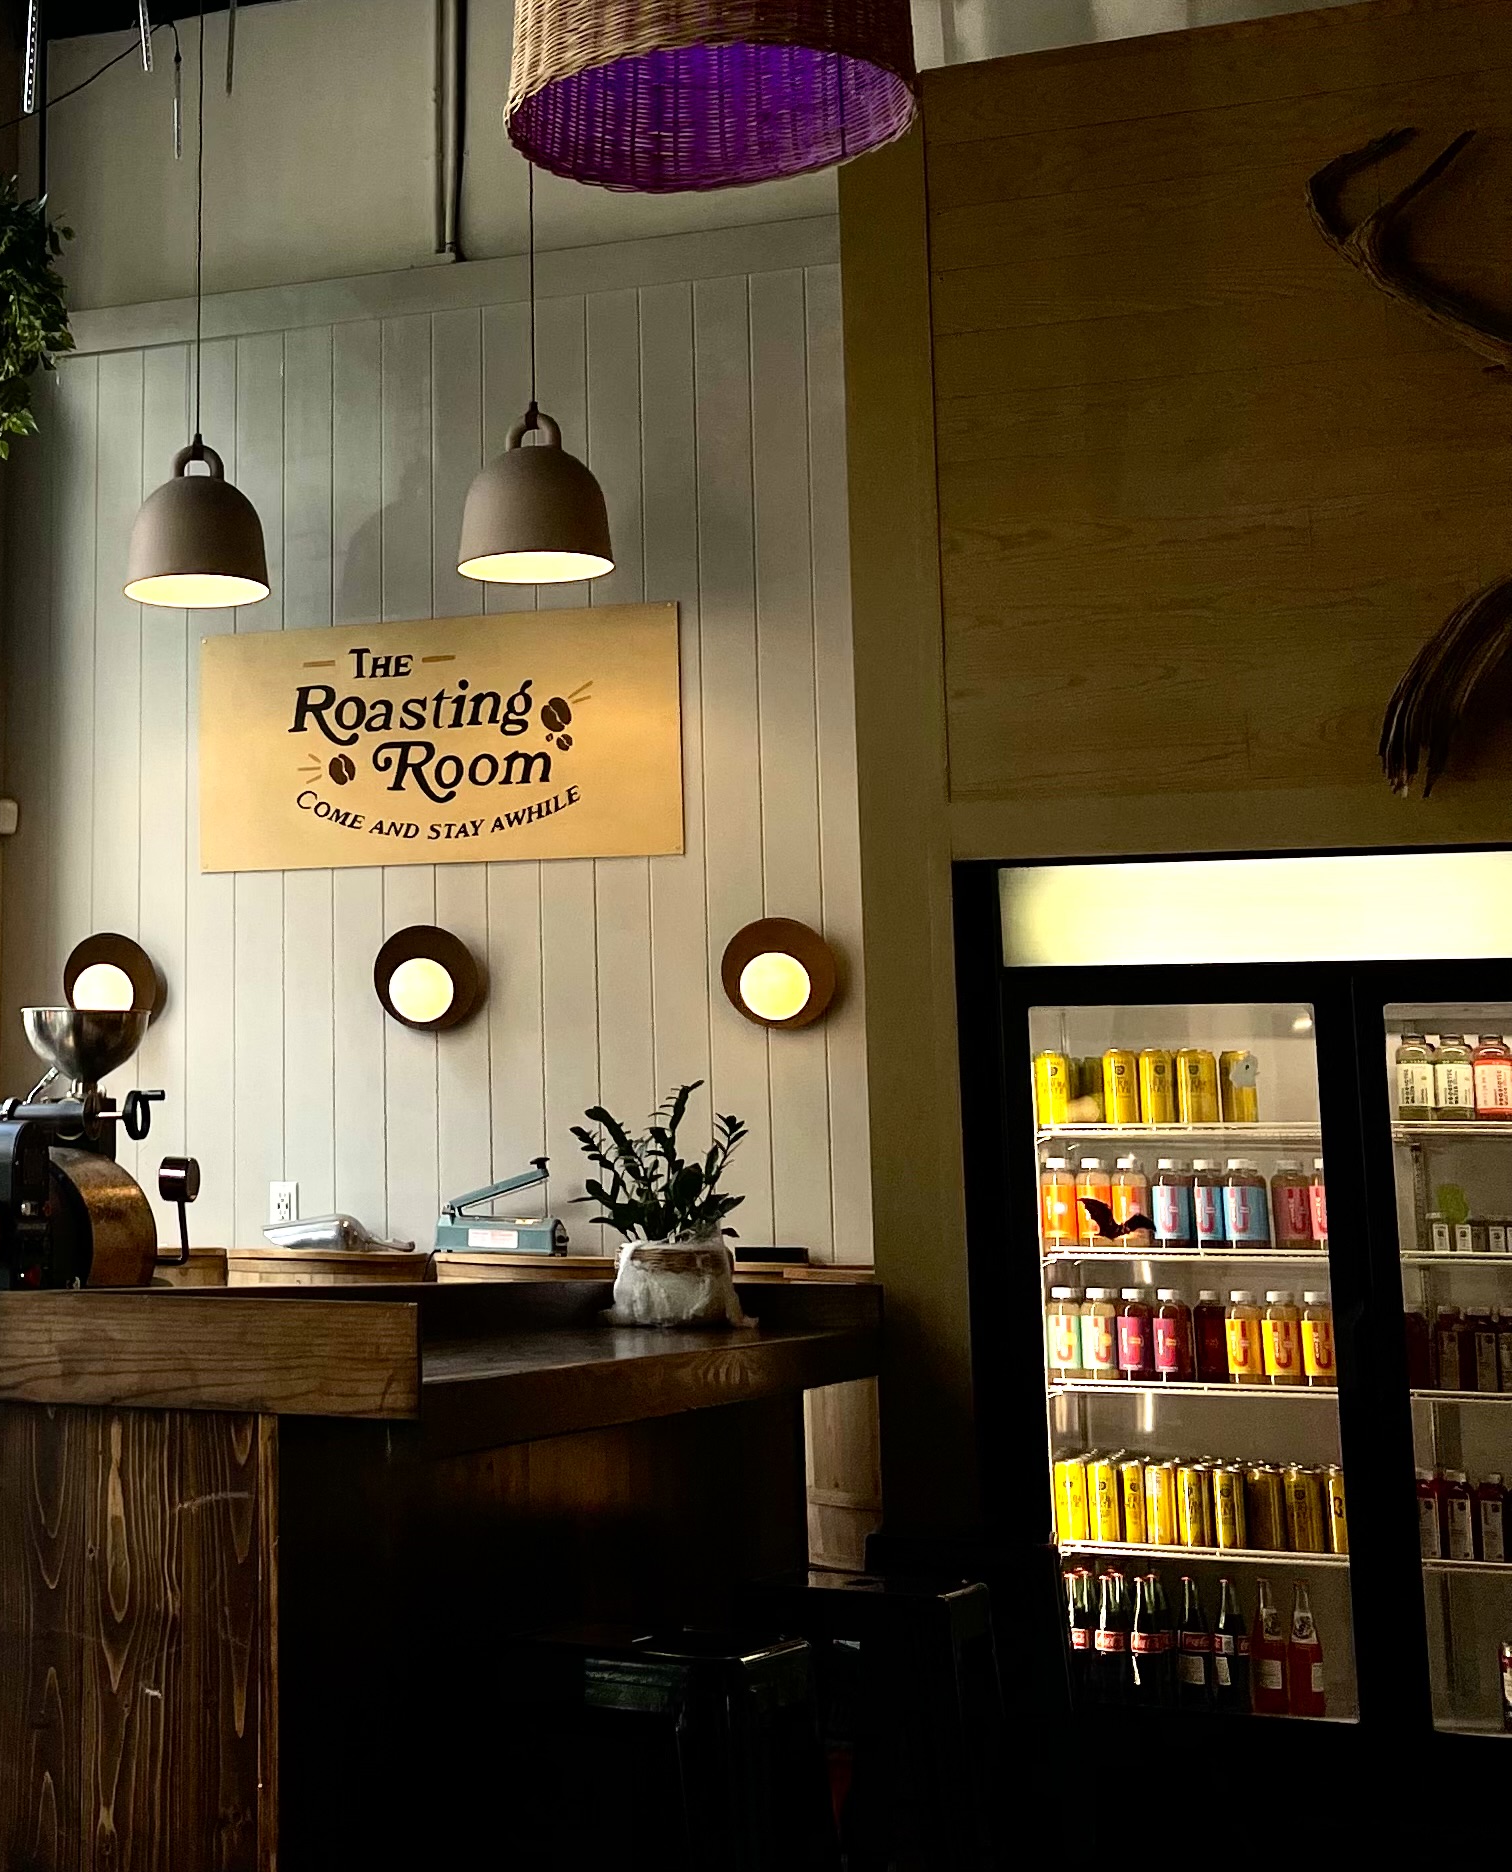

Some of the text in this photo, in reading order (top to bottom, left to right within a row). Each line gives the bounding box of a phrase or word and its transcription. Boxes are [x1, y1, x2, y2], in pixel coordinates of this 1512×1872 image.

[348, 647, 414, 679] THE
[287, 679, 533, 746] Roasting
[372, 740, 553, 804] Room
[296, 784, 582, 841] COME AND STAY AWHILE
